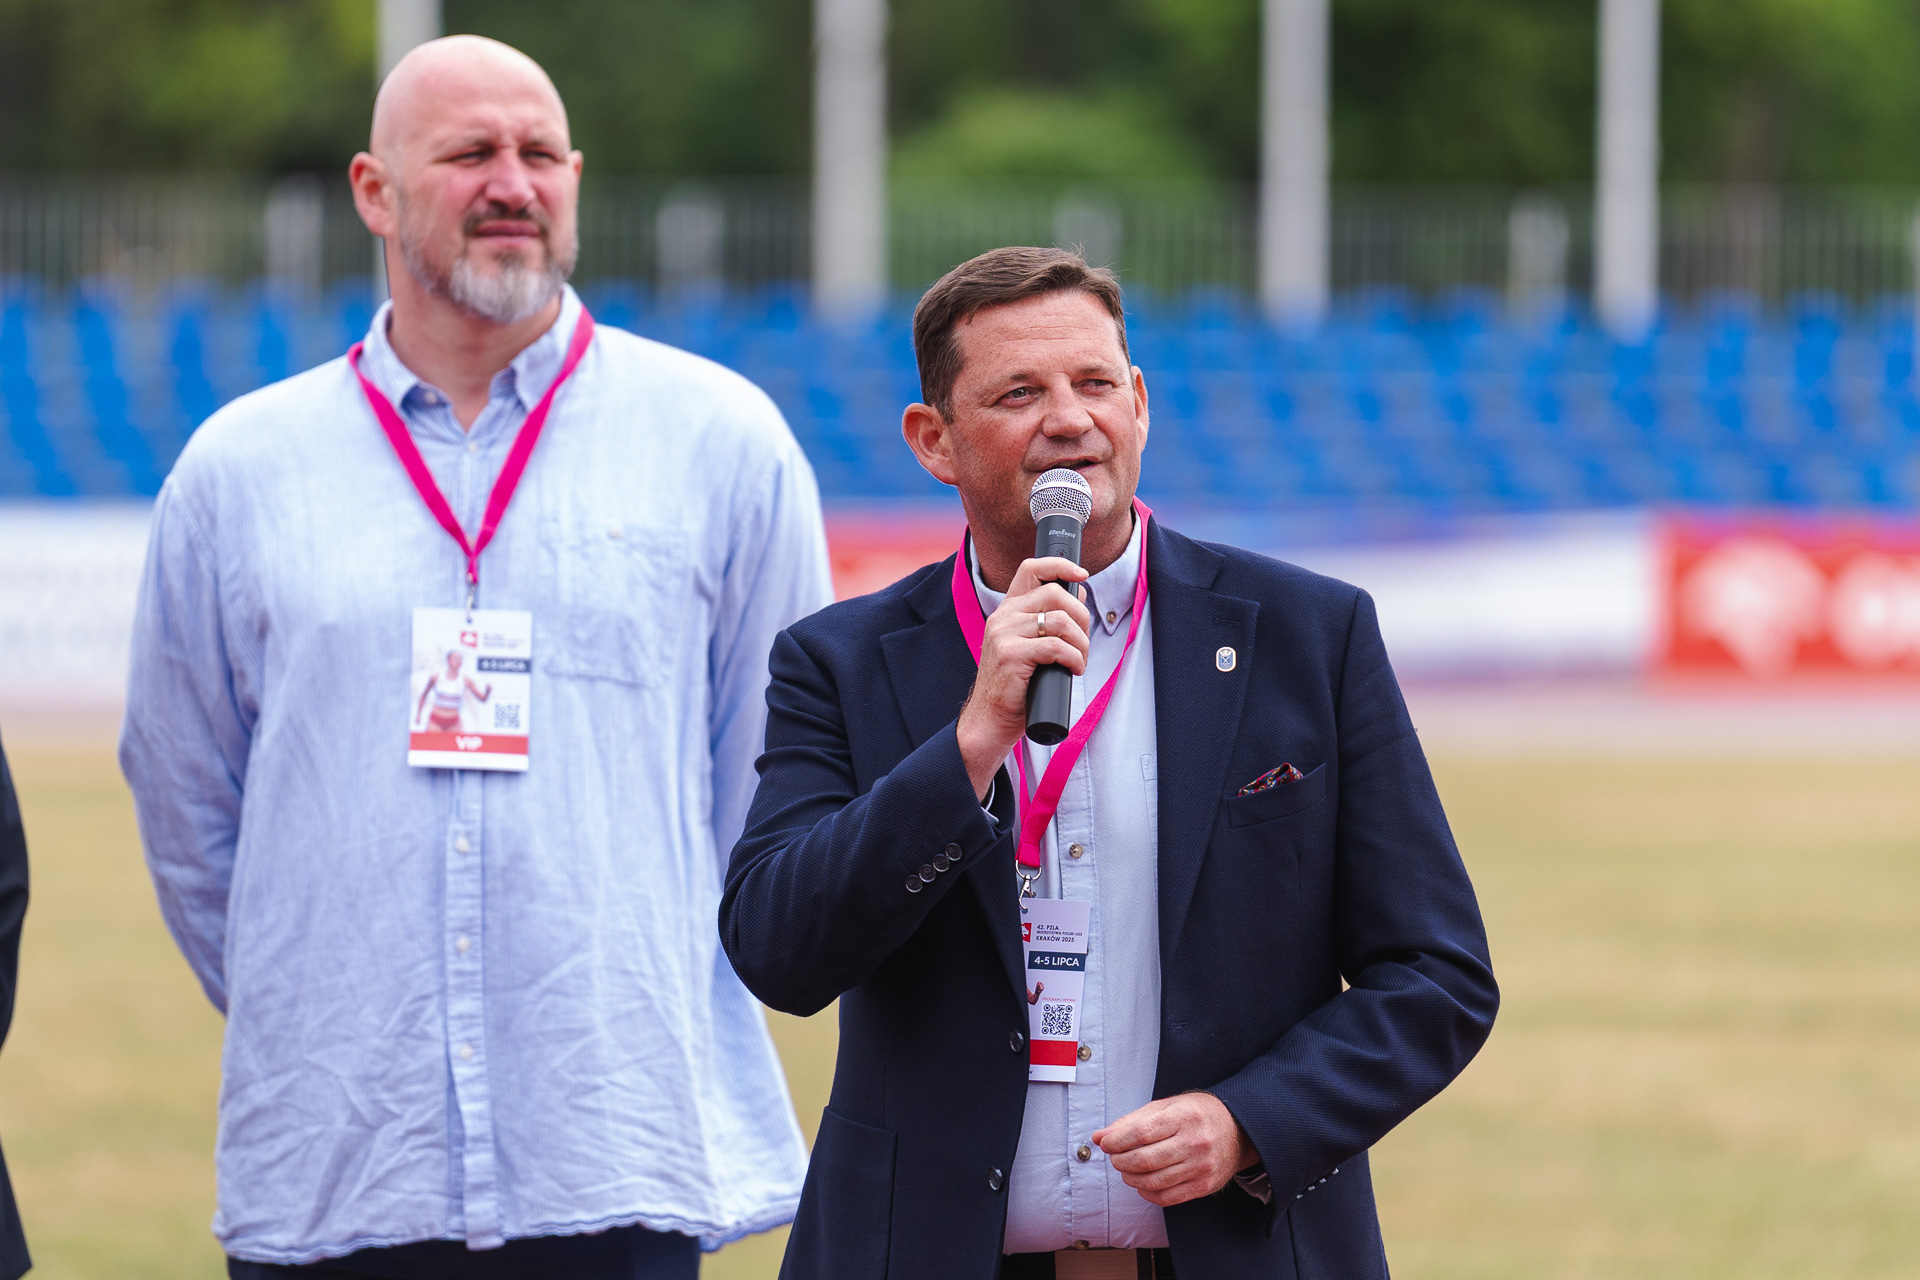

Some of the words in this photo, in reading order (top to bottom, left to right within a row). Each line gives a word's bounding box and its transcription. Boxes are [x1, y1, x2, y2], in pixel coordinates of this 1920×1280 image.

[455, 735, 483, 751] VIP
[1034, 956, 1050, 965] 4-5
[1052, 956, 1080, 967] LIPCA
